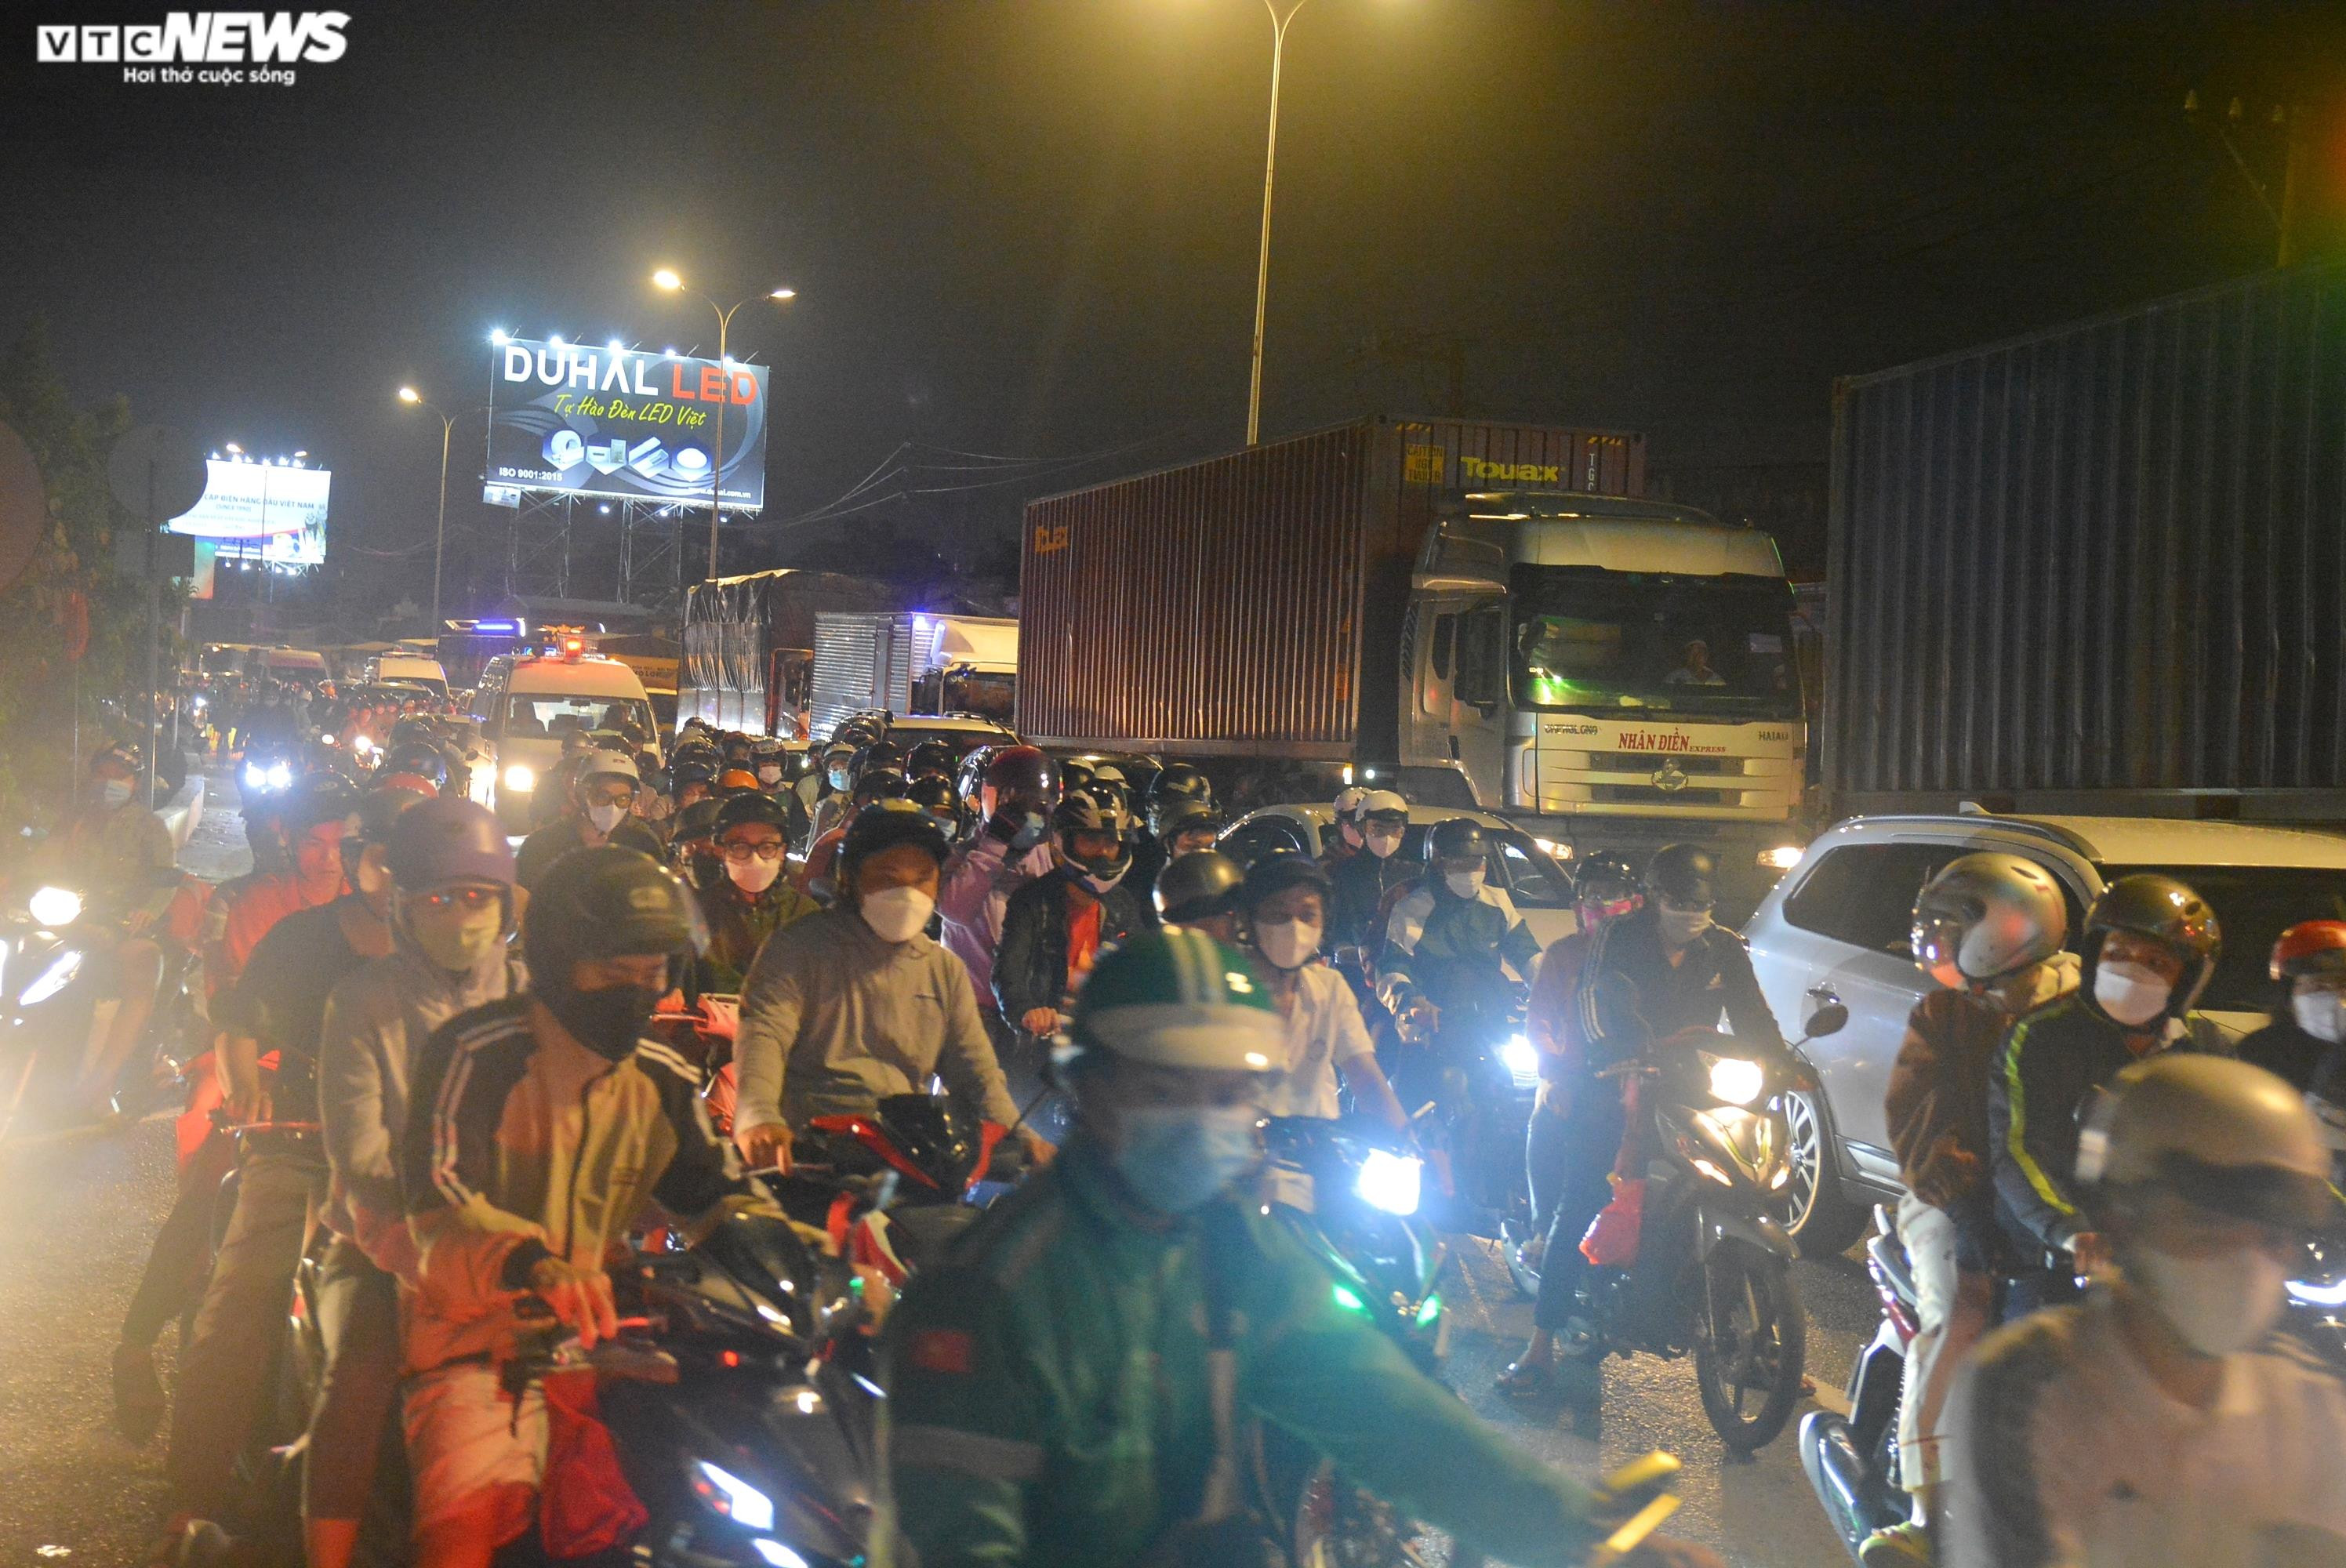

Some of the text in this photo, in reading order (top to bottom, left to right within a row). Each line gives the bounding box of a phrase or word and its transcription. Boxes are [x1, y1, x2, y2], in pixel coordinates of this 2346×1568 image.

[504, 345, 757, 405] DUHAL LED
[554, 394, 707, 430] Tự Hào Đèn LED Việt
[499, 467, 563, 482] ISO 9001:2015
[1618, 730, 1656, 751] NHÂN
[1658, 728, 1690, 752] ĐIỀN
